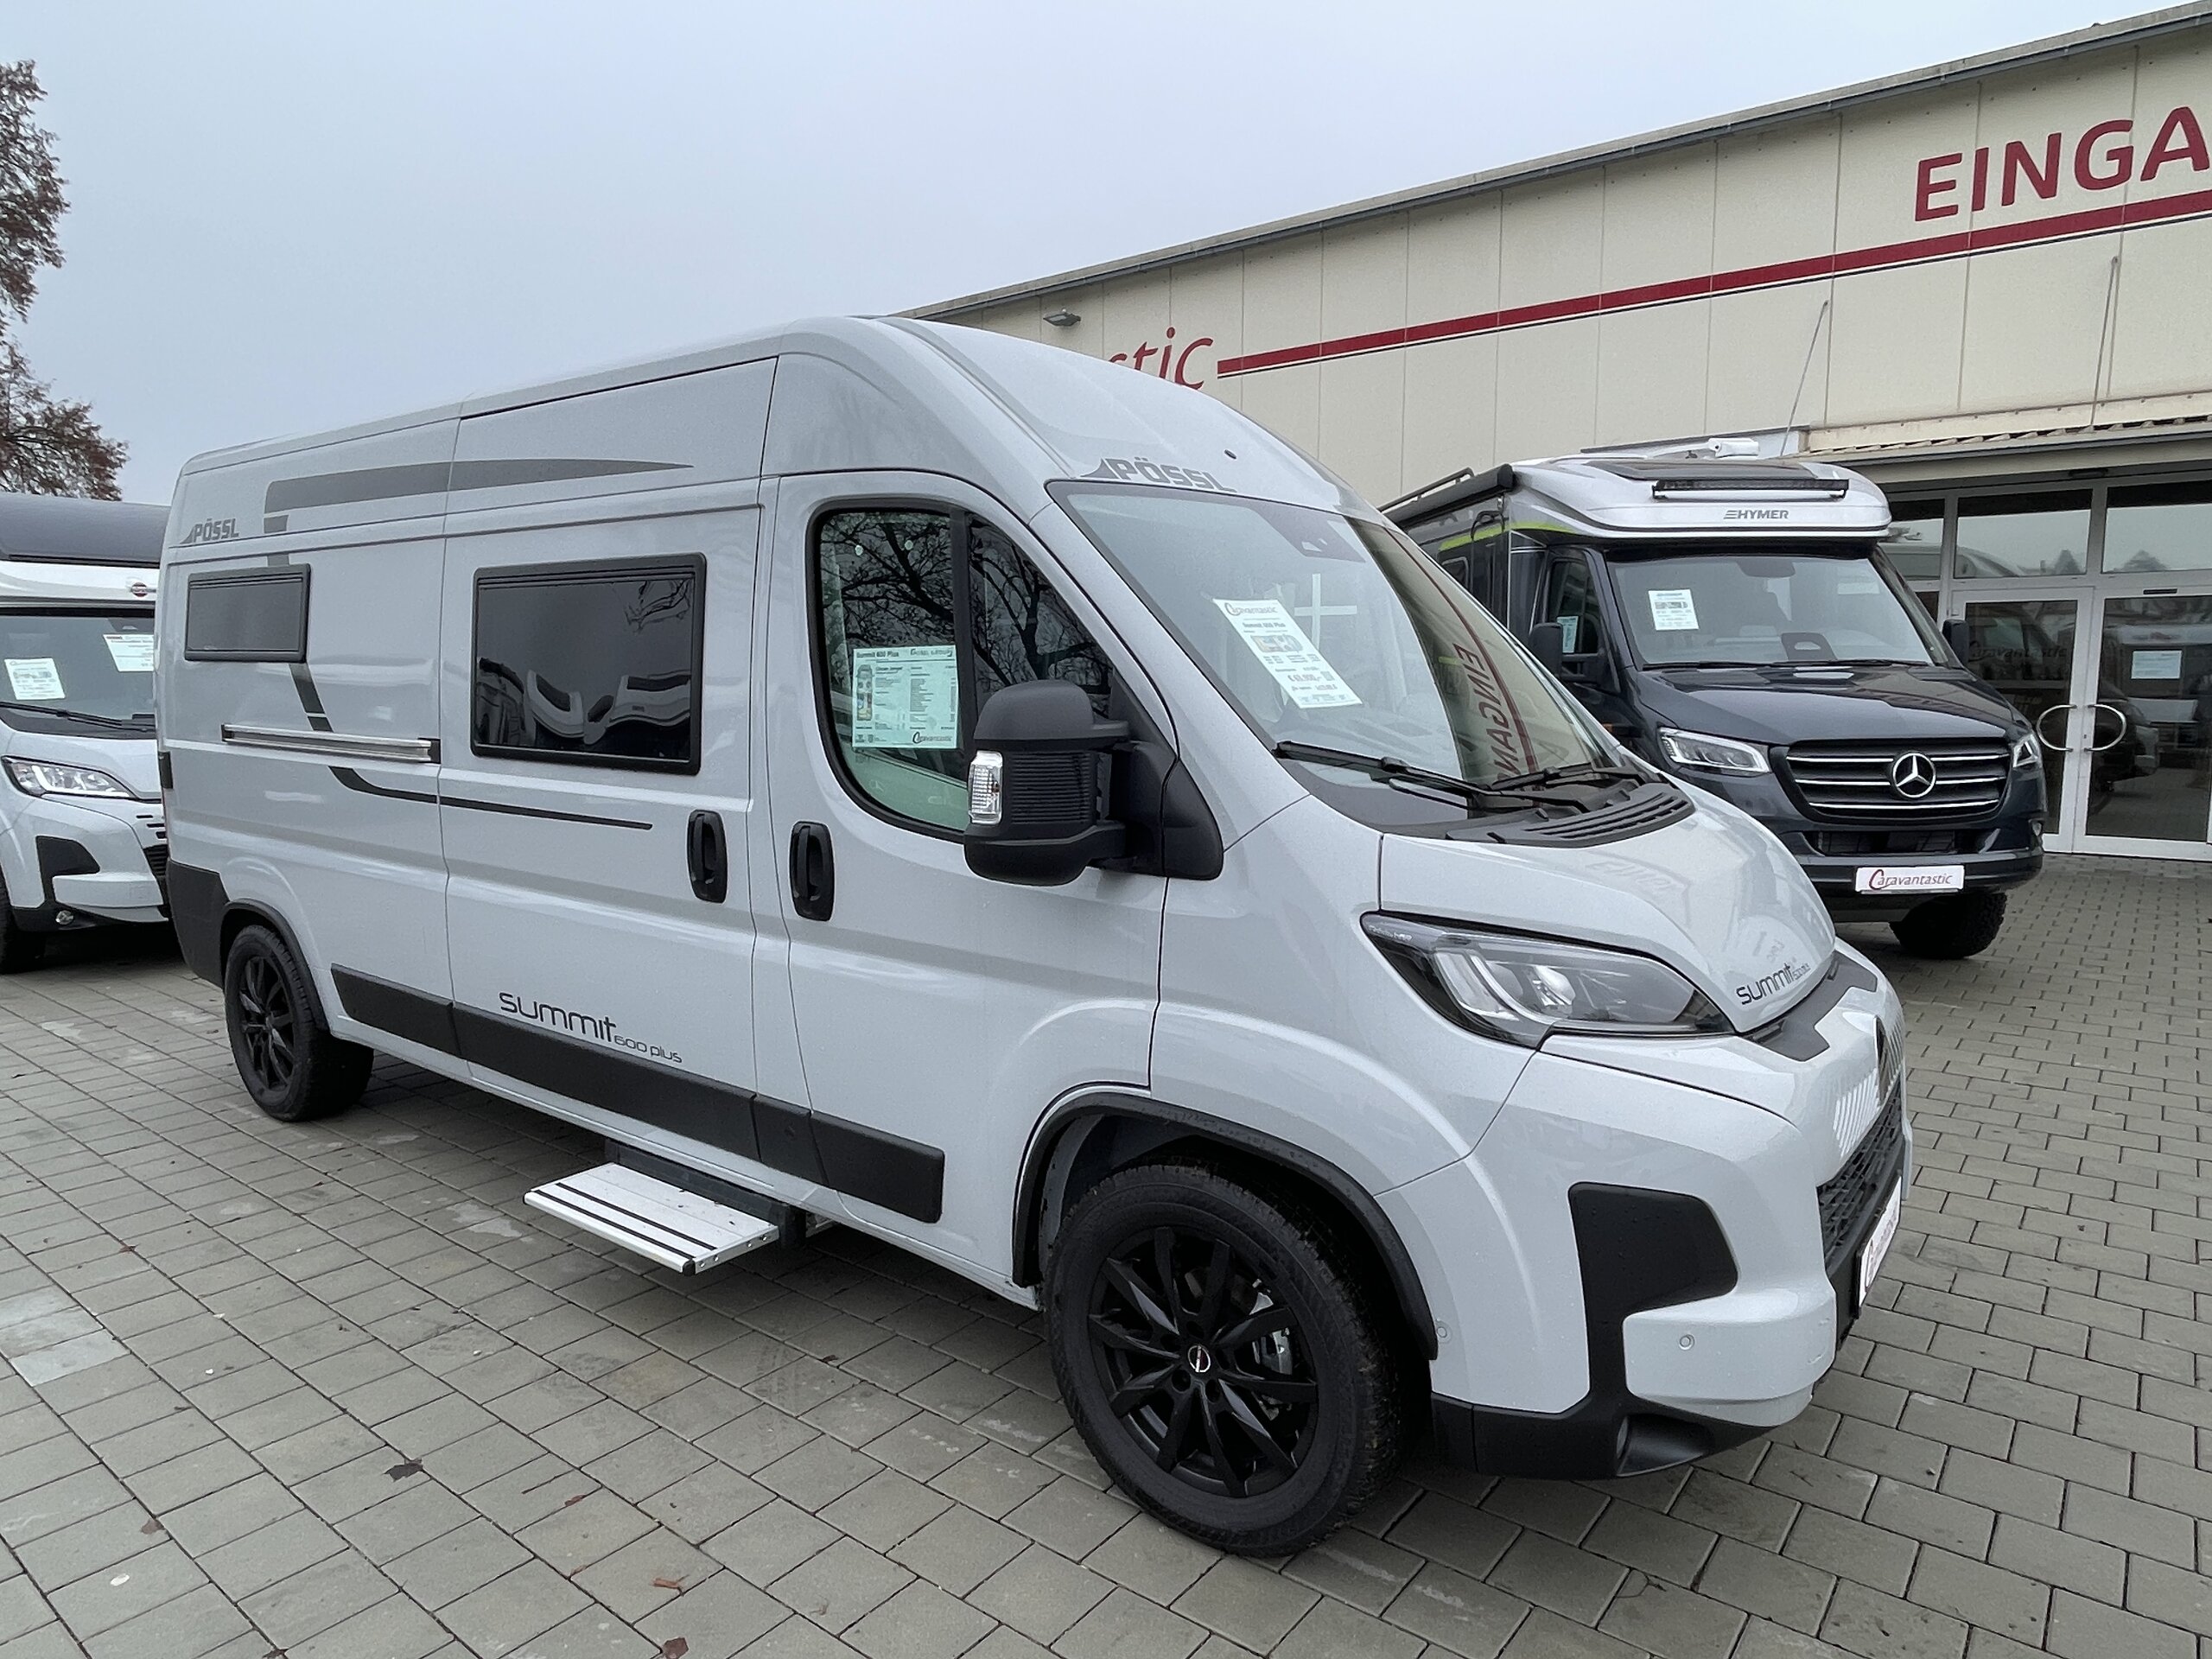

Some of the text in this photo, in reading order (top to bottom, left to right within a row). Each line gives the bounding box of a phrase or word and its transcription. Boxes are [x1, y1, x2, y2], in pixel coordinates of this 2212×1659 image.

[1915, 106, 2209, 221] EINGA
[1109, 327, 1213, 390] tic
[1105, 456, 1237, 493] PÖSSL
[193, 518, 239, 543] PÖSSL
[1737, 510, 1789, 519] HYMER
[1868, 868, 1953, 890] Caravantastic
[499, 992, 683, 1064] summit 600 plus
